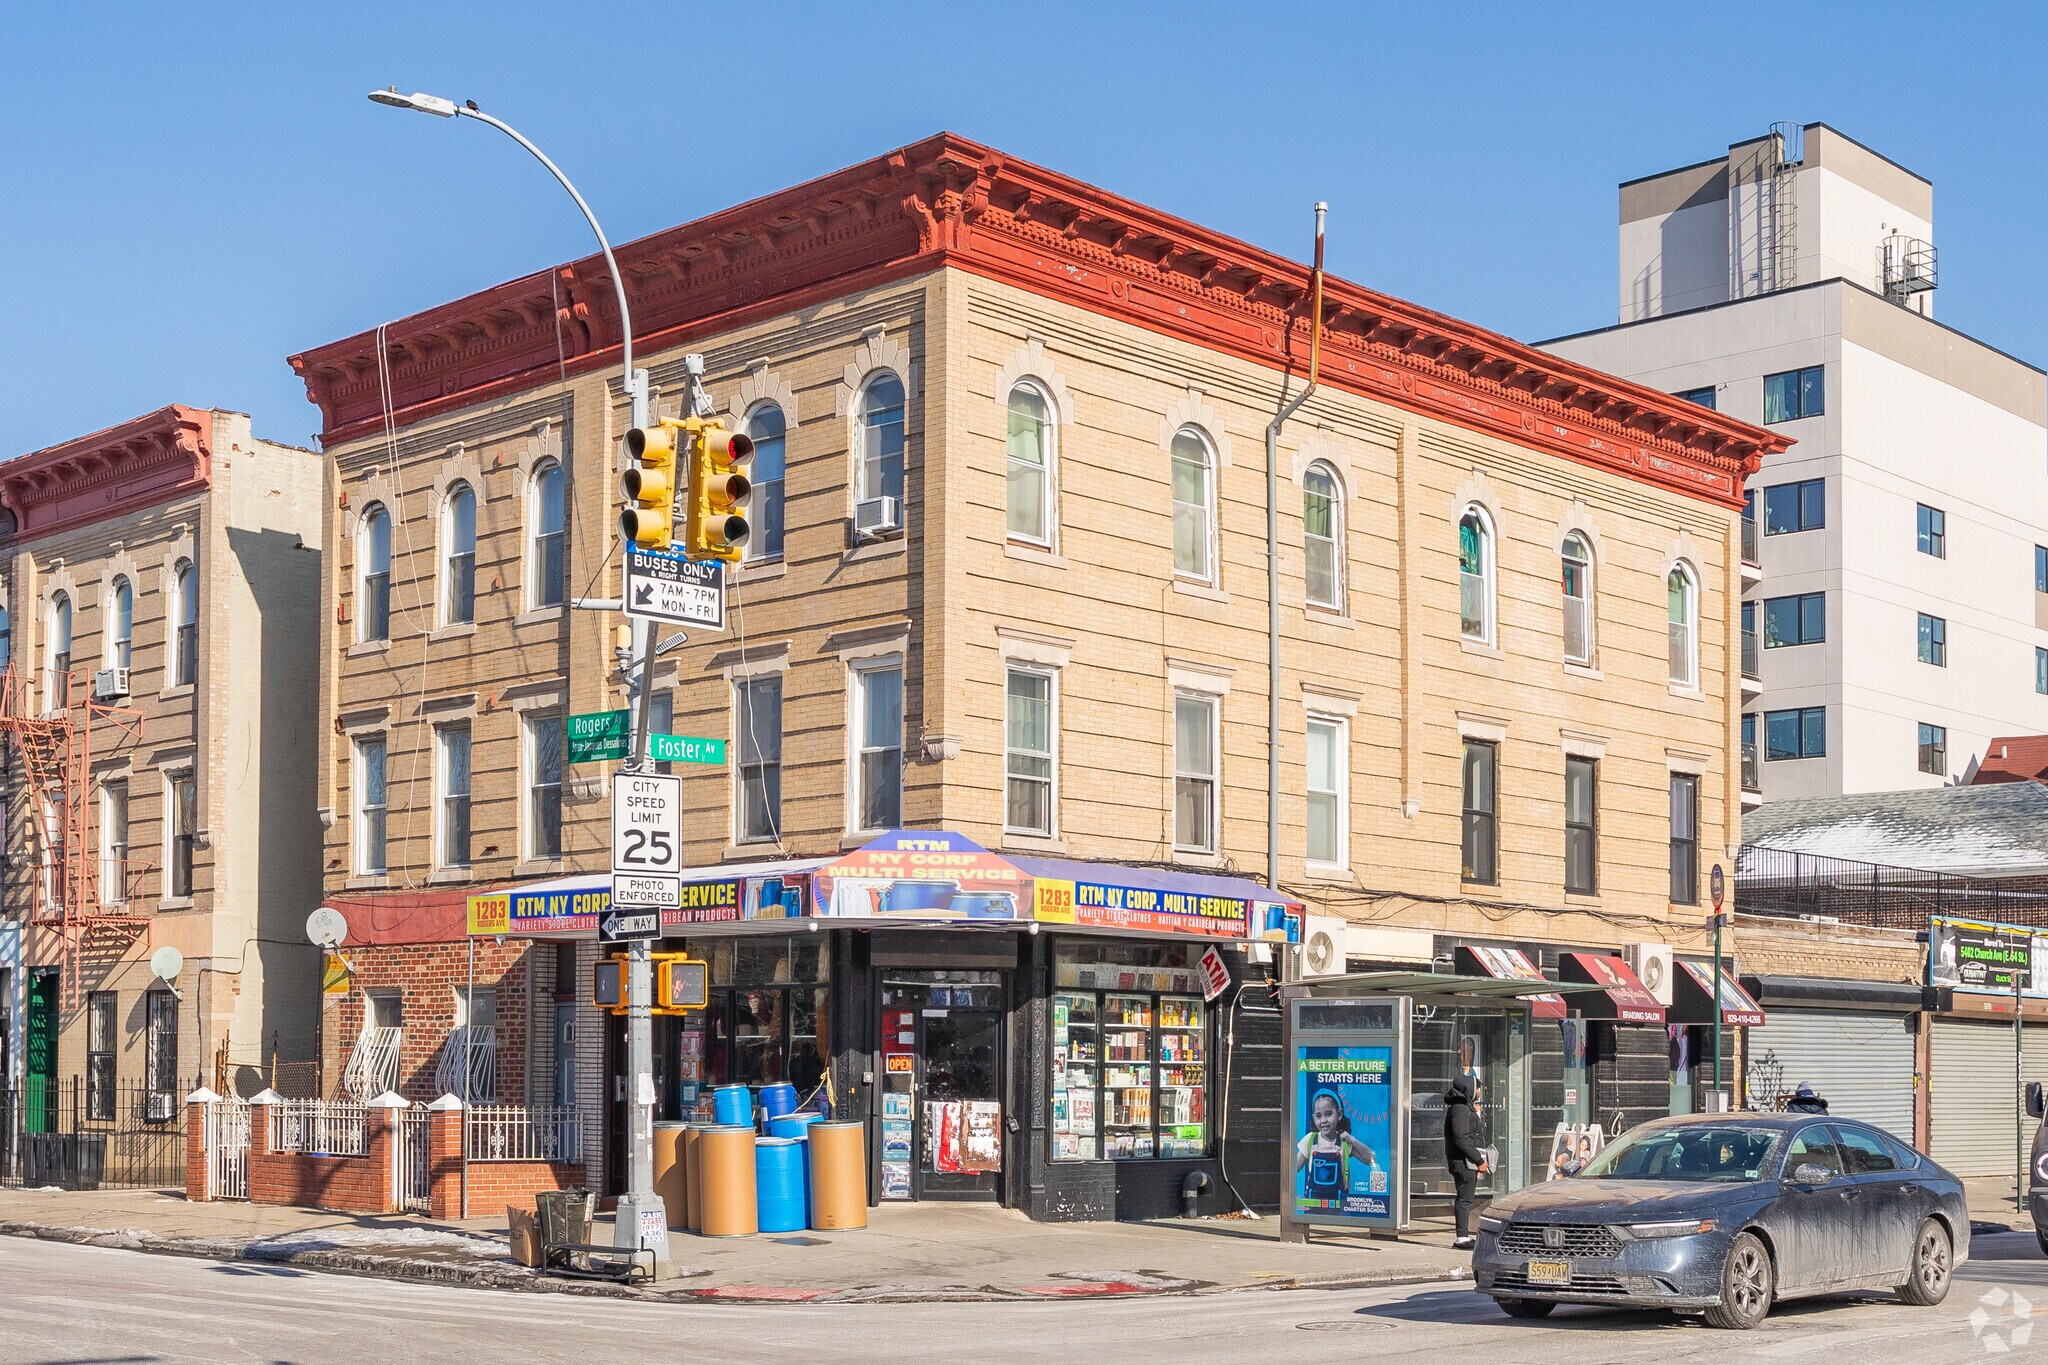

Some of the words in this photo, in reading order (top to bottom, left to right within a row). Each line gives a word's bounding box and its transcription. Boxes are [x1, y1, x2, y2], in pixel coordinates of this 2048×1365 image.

[634, 554, 678, 573] BUSES
[683, 562, 715, 580] ONLY
[659, 572, 678, 581] RIGHT
[680, 575, 700, 585] TURNS
[660, 583, 684, 597] 7AM
[694, 589, 716, 603] 7PM
[662, 599, 686, 613] MON
[697, 605, 714, 618] FRI
[575, 717, 611, 737] Rogers
[614, 714, 623, 724] Av
[659, 738, 700, 759] Foster
[706, 742, 715, 754] Av
[633, 782, 660, 793] CITY
[627, 797, 666, 809] SPEED
[631, 813, 662, 824] LIMIT
[623, 829, 673, 866] 25
[897, 840, 950, 851] RTM
[869, 853, 905, 865] NY
[910, 853, 978, 866] CORP
[829, 866, 905, 879] MULTI
[912, 868, 1018, 881] SERVICE
[631, 880, 664, 890] PHOTO
[517, 897, 545, 917] RTM
[549, 896, 569, 915] NY
[573, 893, 615, 913] CORP.
[682, 883, 736, 908] ERVICE
[620, 891, 674, 902] ENFORCED
[1040, 888, 1071, 907] 1283
[1080, 885, 1105, 906] RTM
[1108, 888, 1124, 907] NY
[1127, 890, 1161, 911] CORP.
[1164, 893, 1197, 915] MULTI
[1200, 897, 1245, 919] SERVICE
[476, 901, 506, 920] 1283
[1041, 906, 1060, 914] ROGERS
[477, 920, 495, 928] ROGERS
[496, 919, 505, 927] AVE
[517, 919, 546, 931] VARIETY
[573, 917, 599, 928] CLOTHE
[695, 909, 737, 922] PRODUCTS
[608, 919, 625, 932] ONE
[634, 917, 653, 930] WAY
[1080, 908, 1104, 920] VARIETY
[1127, 911, 1151, 924] CLOTHES
[1159, 915, 1181, 926] HAITIAN
[1189, 918, 1216, 930] CARIBEAN
[1217, 921, 1245, 933] PRODUCTS
[1975, 947, 1993, 960] Church
[1994, 949, 2003, 961] Ave
[1202, 952, 1227, 993] ATM
[1623, 1011, 1644, 1020] BRAIDING
[1645, 1012, 1660, 1021] SALON
[889, 1057, 913, 1072] OPEN
[1300, 1061, 1307, 1070] A
[1309, 1061, 1345, 1071] BETTER
[1348, 1061, 1385, 1071] FUTURE
[1318, 1073, 1353, 1083] STARTS
[1356, 1074, 1382, 1083] HERE
[642, 1212, 662, 1220] CASH
